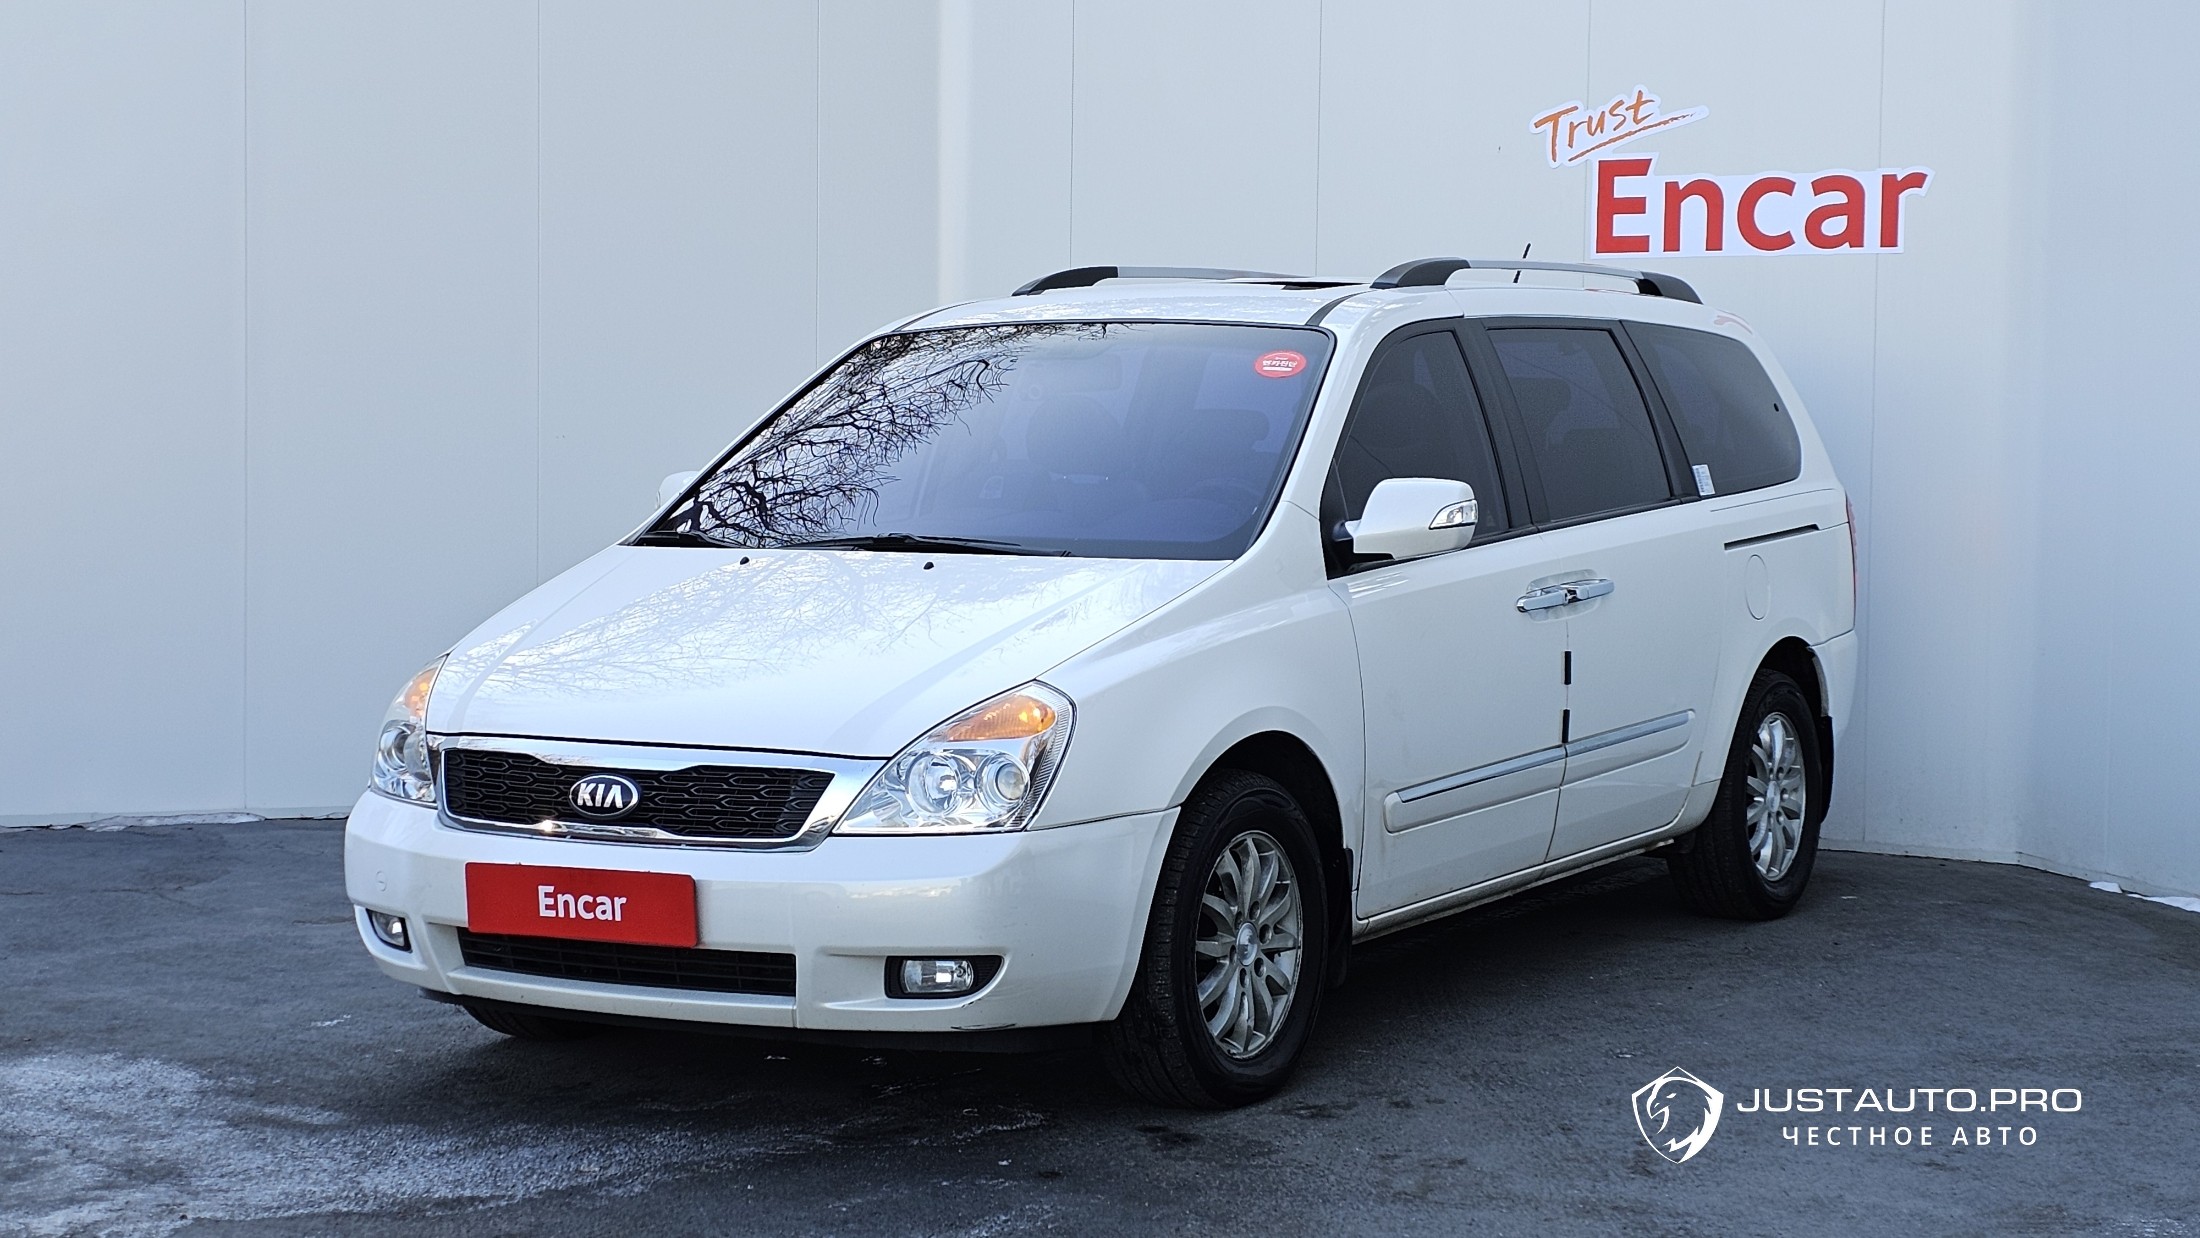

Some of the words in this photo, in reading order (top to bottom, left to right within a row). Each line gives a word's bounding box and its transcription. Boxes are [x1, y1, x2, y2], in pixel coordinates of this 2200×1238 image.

[1534, 90, 1655, 162] Trust
[1596, 158, 1928, 254] Encar
[577, 783, 623, 809] KIA
[537, 885, 627, 921] Encar
